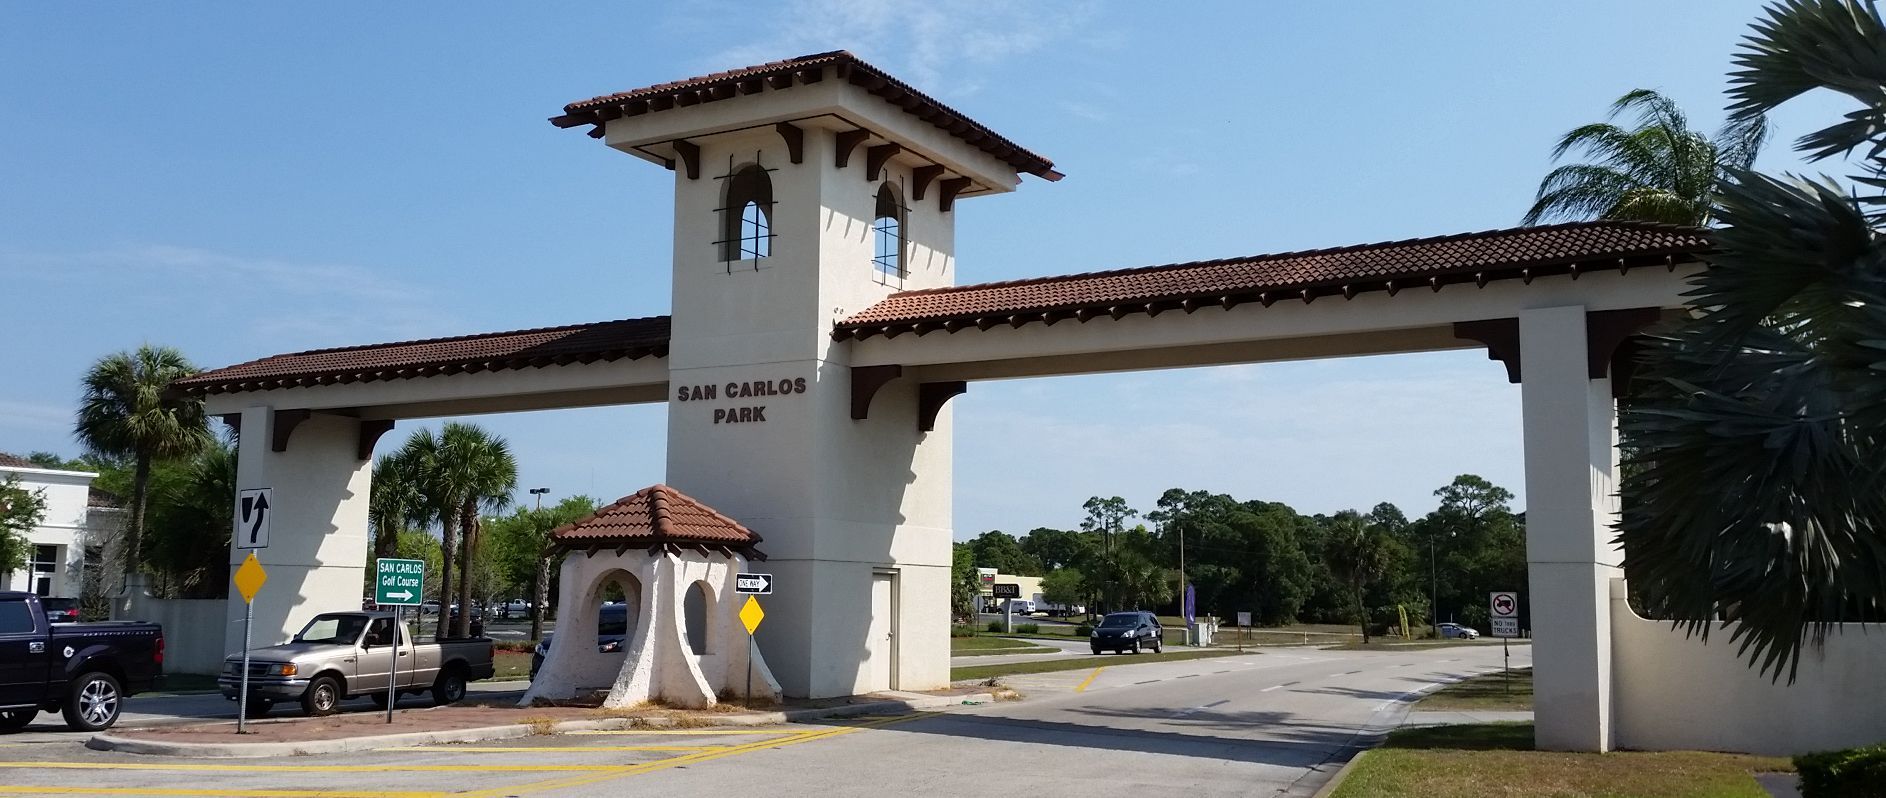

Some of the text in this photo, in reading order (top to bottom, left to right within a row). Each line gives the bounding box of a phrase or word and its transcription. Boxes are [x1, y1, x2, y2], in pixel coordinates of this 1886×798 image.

[678, 377, 806, 401] SAN CARLOS
[713, 406, 766, 424] PARK
[380, 563, 422, 574] SAN CARLOS
[382, 575, 419, 587] Golf Course
[995, 585, 1016, 594] BB&T
